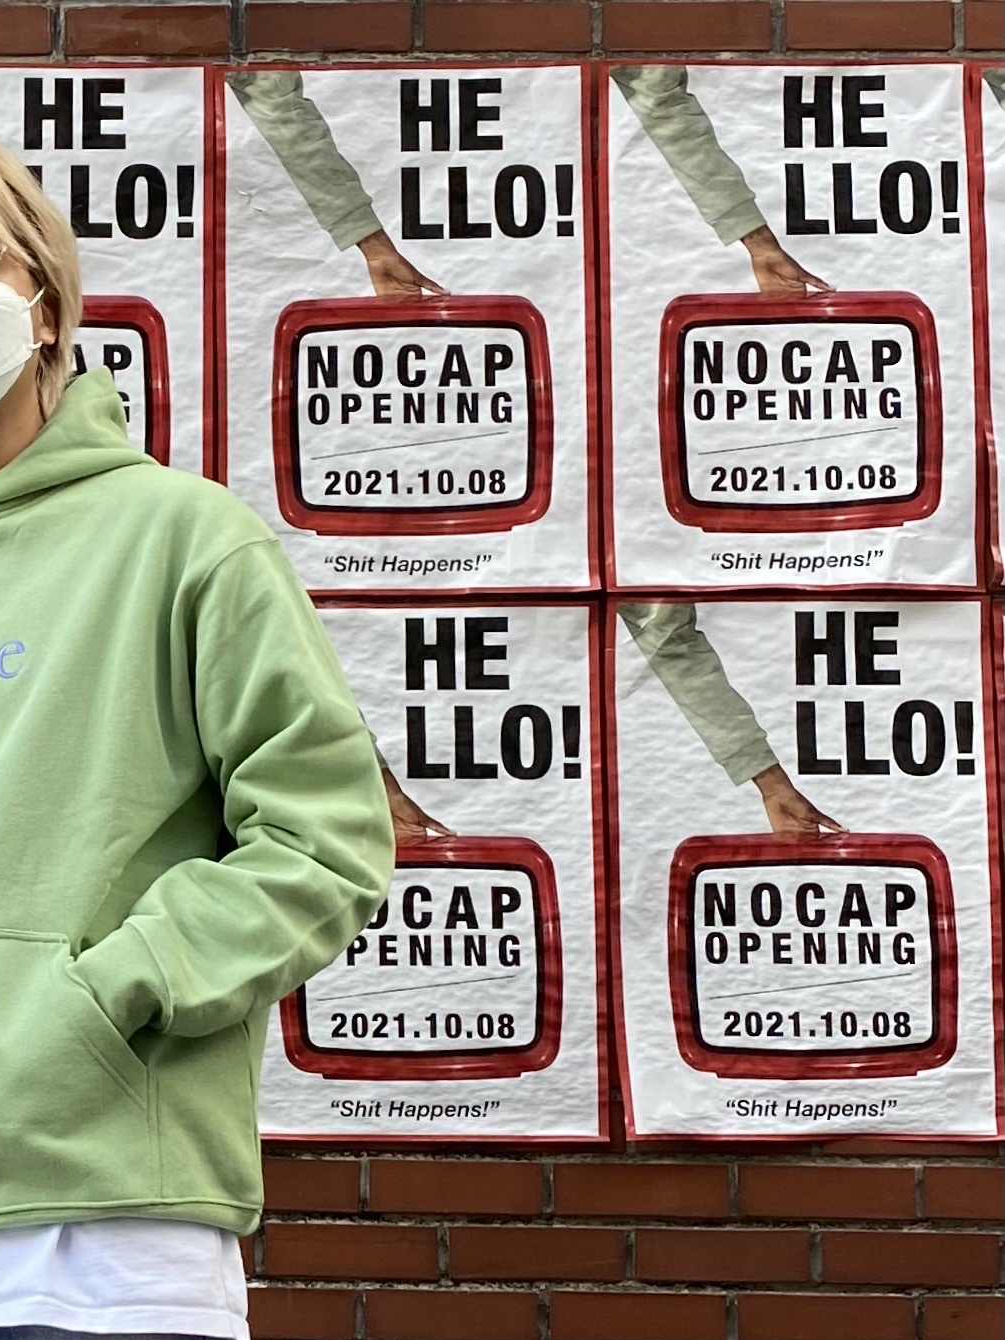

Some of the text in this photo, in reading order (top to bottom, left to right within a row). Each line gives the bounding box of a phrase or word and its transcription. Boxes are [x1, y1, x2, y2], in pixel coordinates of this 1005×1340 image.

[24, 78, 126, 150] HE
[401, 78, 502, 152] HE
[784, 75, 887, 148] HE
[26, 164, 194, 239] LO!
[401, 165, 574, 239] LLO!
[785, 161, 960, 235] LLO!
[308, 344, 513, 388] NOCAP
[694, 340, 901, 384] NOCAP
[308, 392, 512, 425] OPENING
[694, 388, 901, 420] OPENING
[325, 470, 505, 495] 2021.10.08
[711, 465, 896, 491] 2021.10.08
[325, 555, 491, 575] “Shit Happens!”
[712, 551, 883, 572] “Shit Happens!”
[405, 617, 509, 690] HE
[795, 611, 900, 685] HE
[406, 705, 581, 780] LLO!
[797, 700, 975, 776] LLO!
[704, 883, 915, 927] NOCAP
[347, 934, 521, 967] PENING
[705, 932, 915, 964] OPENING
[332, 1013, 514, 1038] 2021.10.08
[724, 1012, 911, 1037] 2021.10.08
[331, 1100, 500, 1120] “Shit Happens!”
[727, 1100, 897, 1120] “Shit Happens!”
